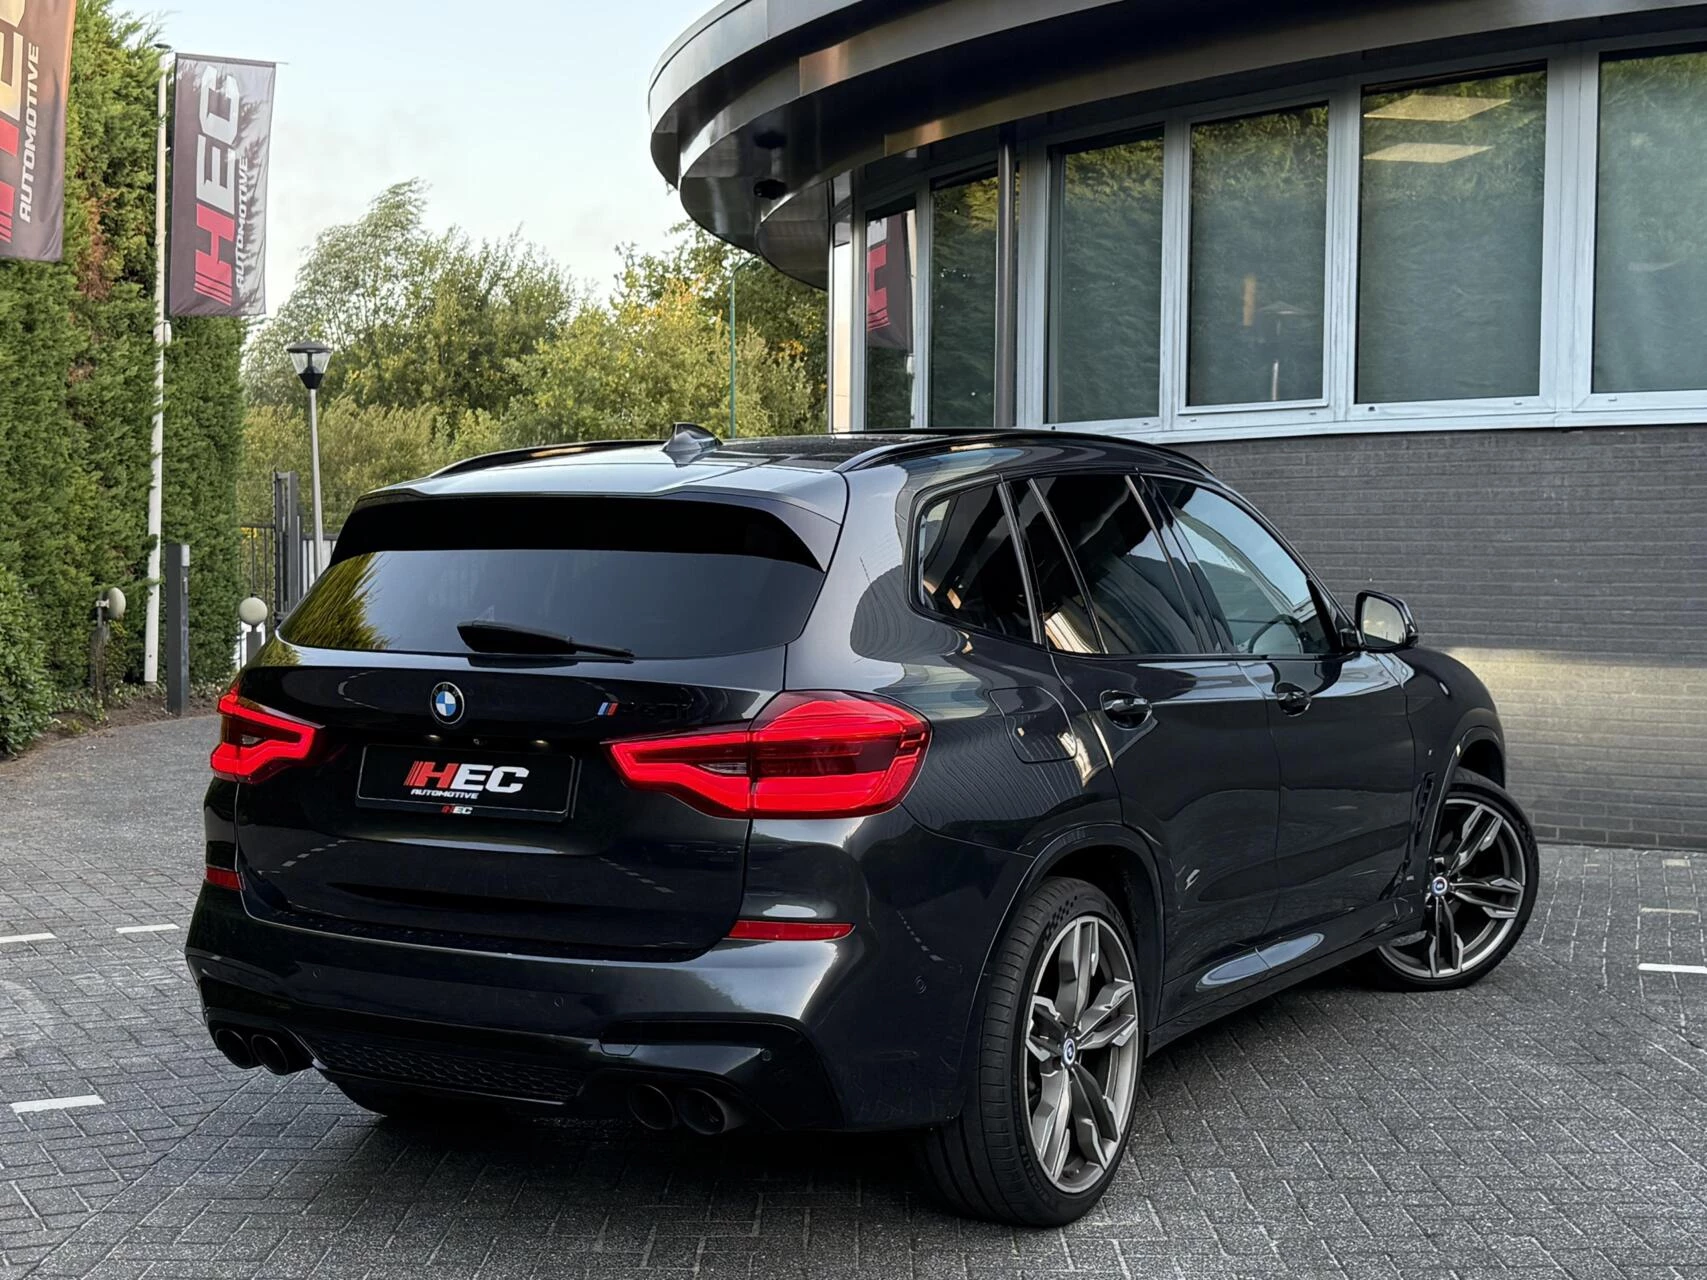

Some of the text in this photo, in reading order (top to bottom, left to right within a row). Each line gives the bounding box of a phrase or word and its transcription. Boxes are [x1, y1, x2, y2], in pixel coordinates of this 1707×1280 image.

[19, 42, 39, 223] AUTOMOTIVE
[193, 65, 240, 306] HEC
[235, 155, 248, 289] AUTOMOTIVE
[403, 760, 529, 793] HEC
[410, 788, 480, 800] AUTOMOTIVE
